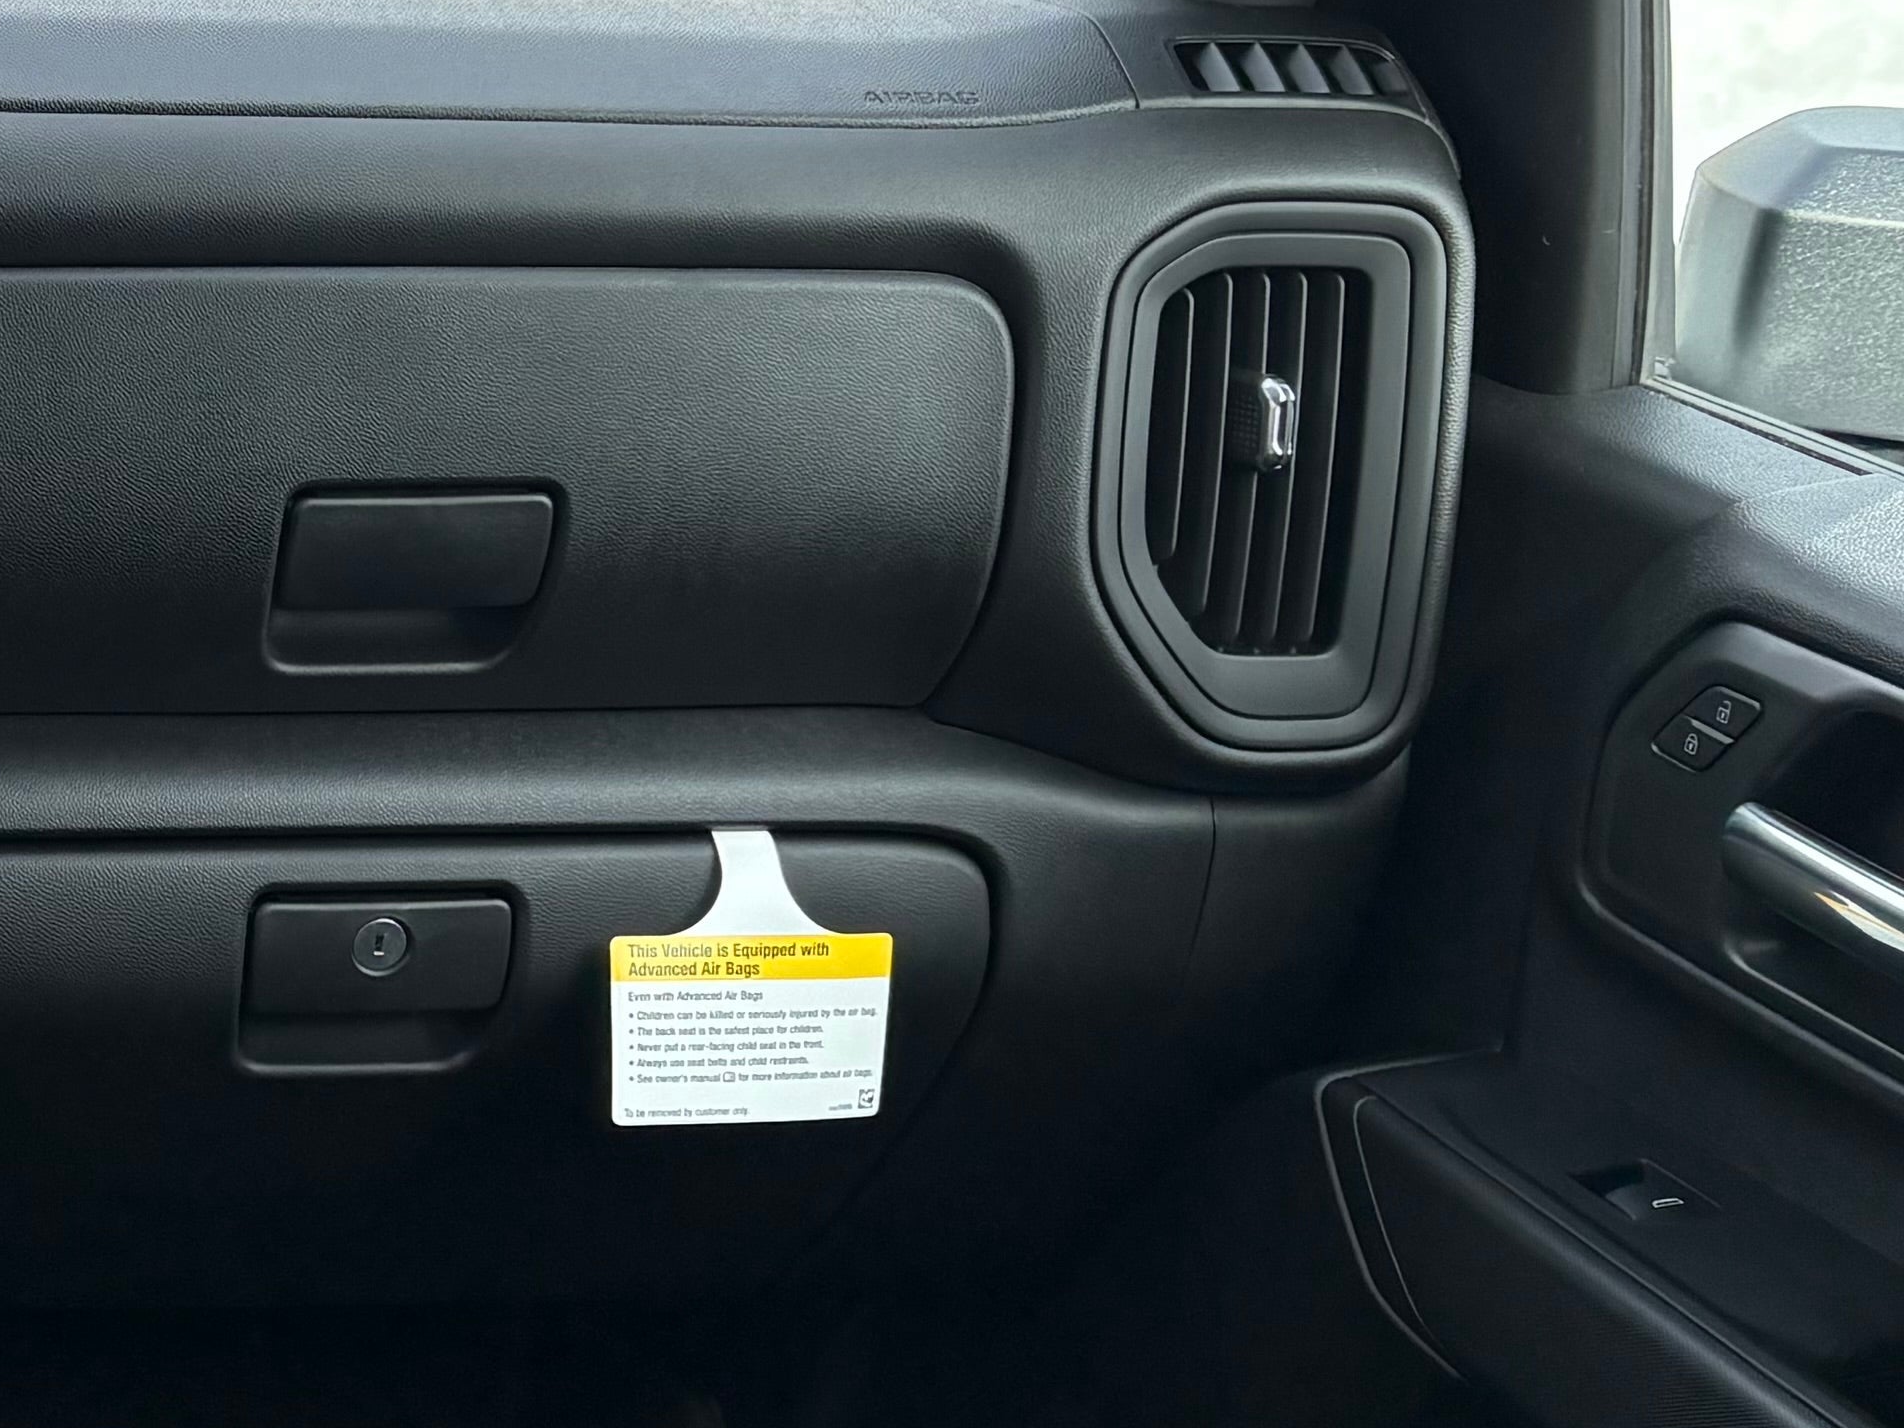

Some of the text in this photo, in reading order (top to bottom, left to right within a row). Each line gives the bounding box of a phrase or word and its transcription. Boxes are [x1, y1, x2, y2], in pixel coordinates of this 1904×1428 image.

[862, 90, 980, 106] AIRBAG
[628, 942, 829, 959] This Vehicle is Equipped with
[628, 961, 761, 979] Advanced Air Bags
[677, 991, 723, 1001] Advanced
[725, 991, 738, 1001] Air
[740, 990, 764, 1002] Bags
[637, 1010, 675, 1020] Children
